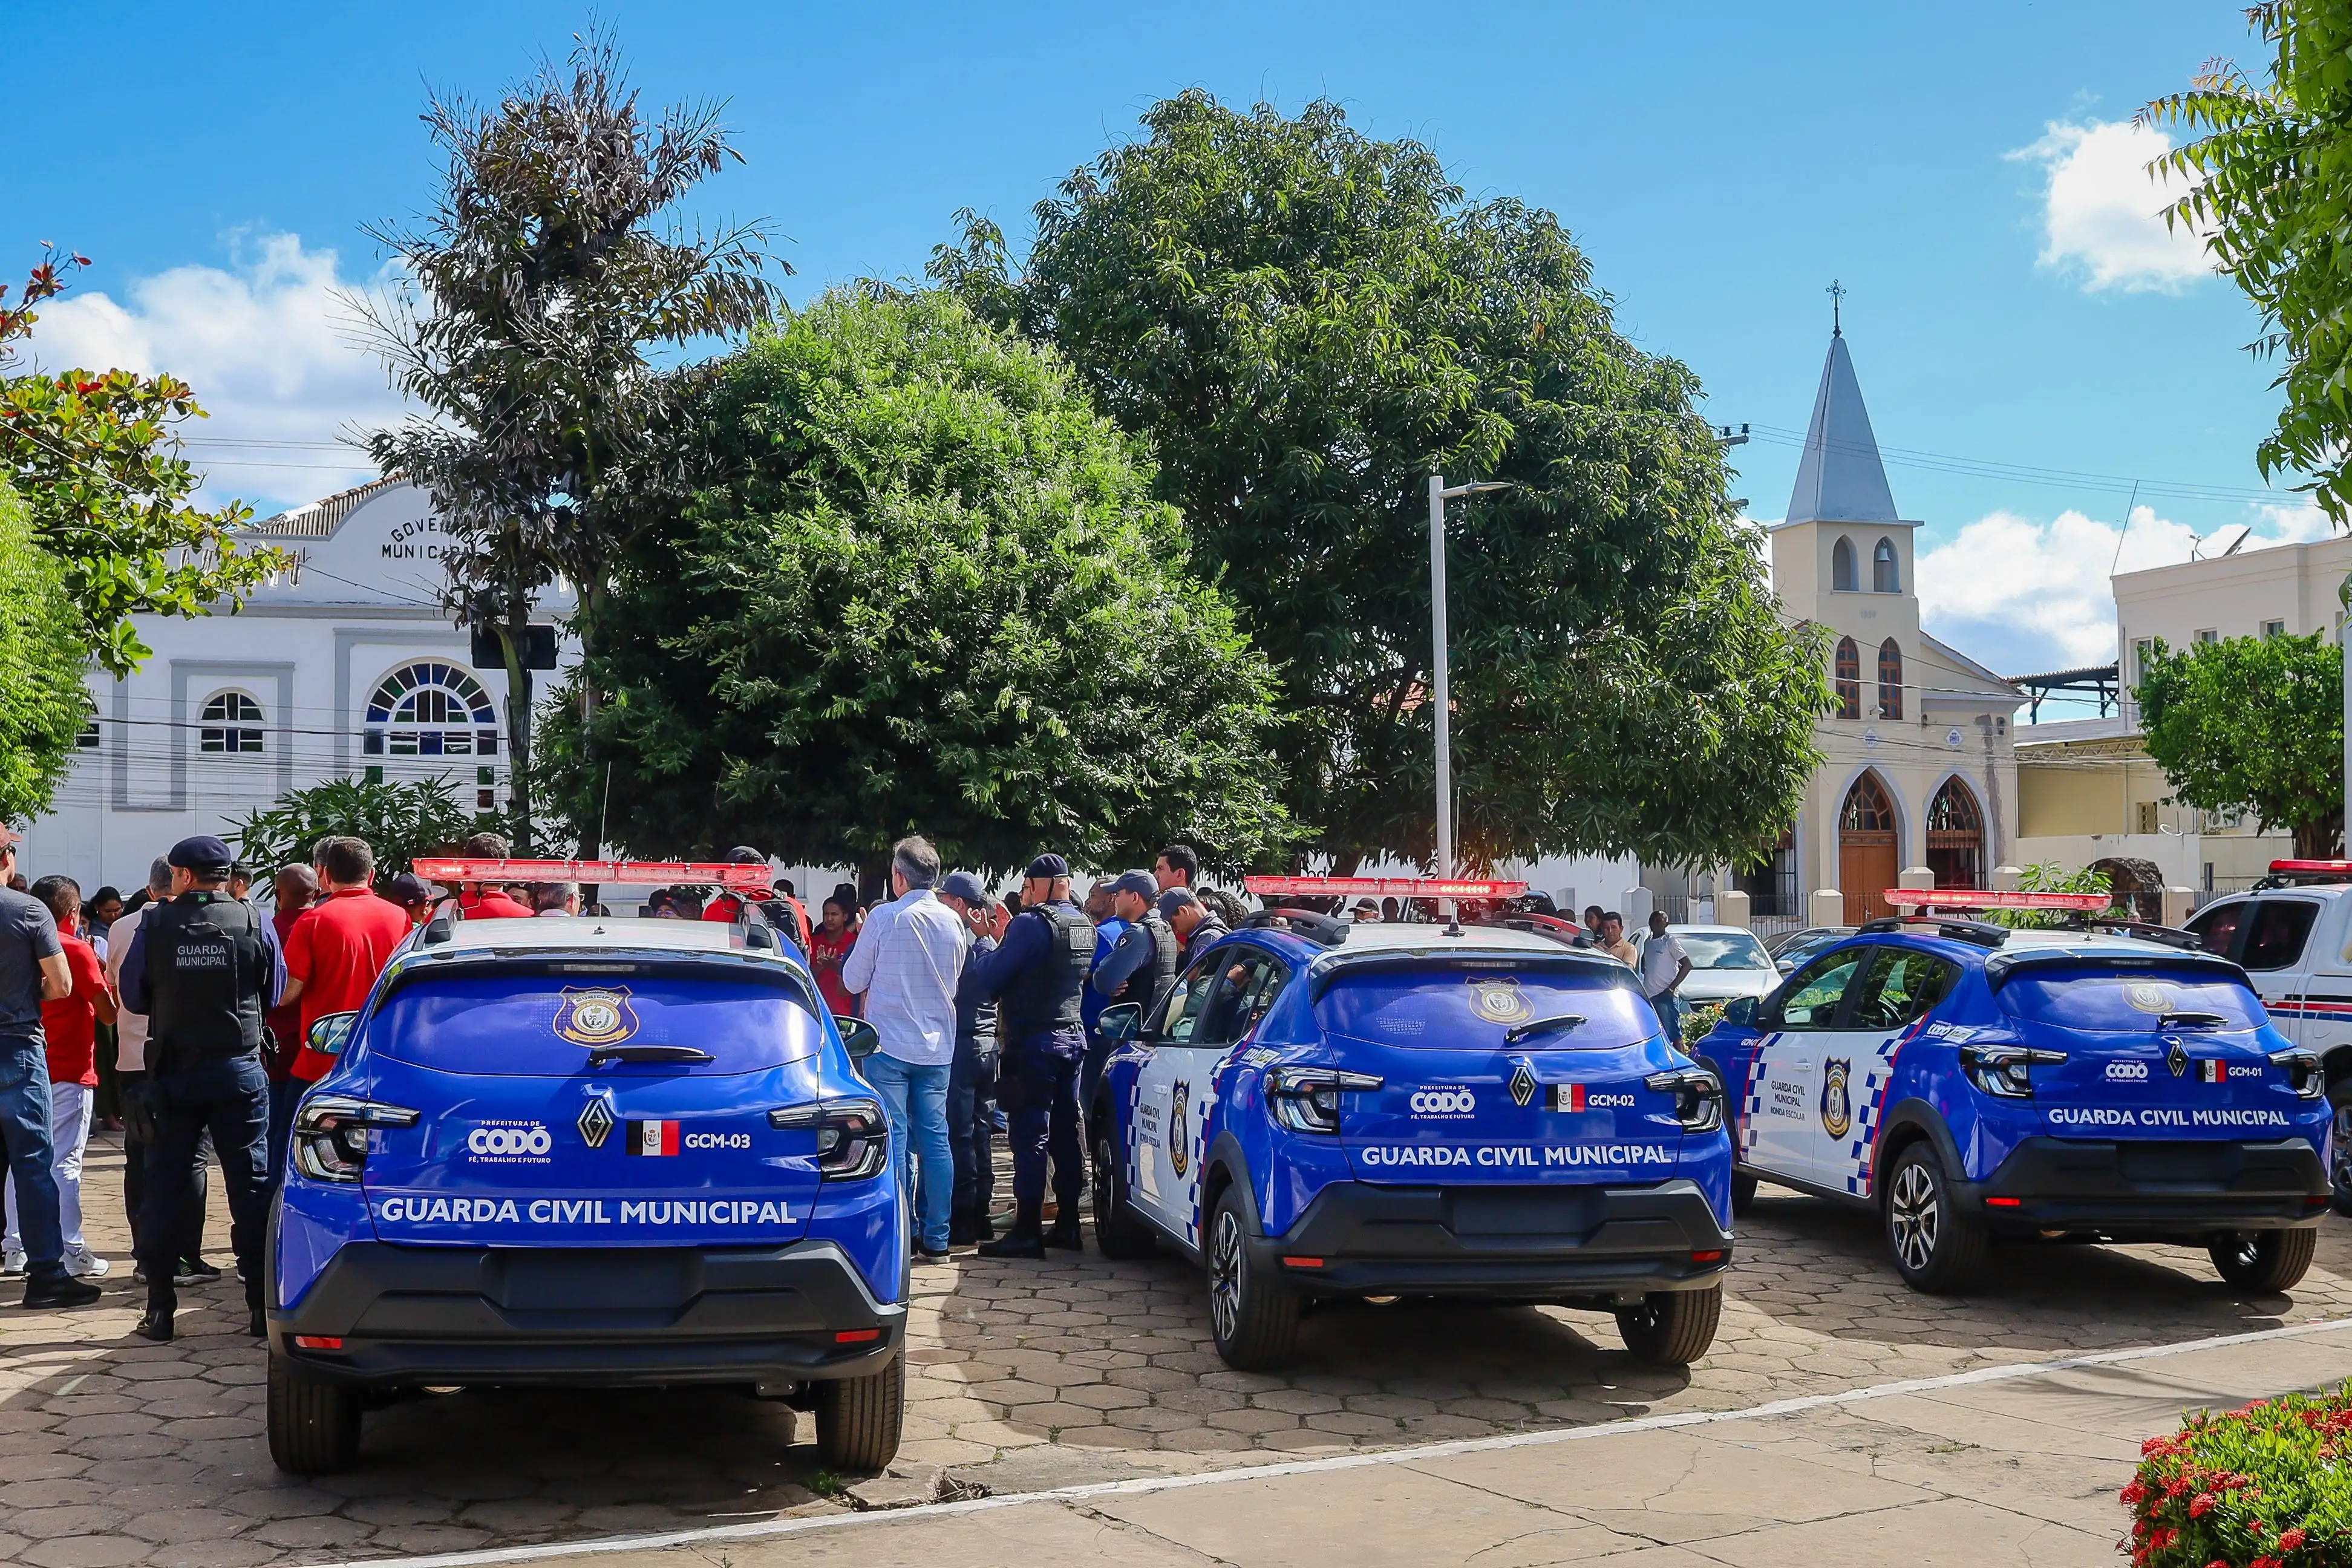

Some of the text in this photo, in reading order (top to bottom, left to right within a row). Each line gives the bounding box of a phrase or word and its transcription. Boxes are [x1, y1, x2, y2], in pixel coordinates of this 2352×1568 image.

[391, 518, 474, 544] GOVEO
[382, 544, 473, 558] MUNICIP
[1071, 928, 1093, 938] GUARDA
[177, 945, 226, 955] GUARDA
[177, 956, 227, 966] MUNICIPAL
[575, 994, 618, 1004] MUNICIPAL
[2105, 1063, 2148, 1078] CODÓ
[2229, 1067, 2262, 1076] GCM-01
[1771, 1080, 1806, 1096] GUARDA CIVIL
[1410, 1088, 1475, 1112] CODÓ
[1589, 1094, 1635, 1106] GCM-02
[1774, 1093, 1801, 1106] MUNICIPAL
[2048, 1109, 2290, 1126] GUARDA CIVIL MUNICIPAL
[468, 1126, 552, 1155] CODÓ
[685, 1134, 751, 1148] GCM-03
[1362, 1145, 1672, 1166] GUARDA CIVIL MUNICIPAL
[381, 1198, 797, 1224] GUARDA CIVIL MUNICIPAL
